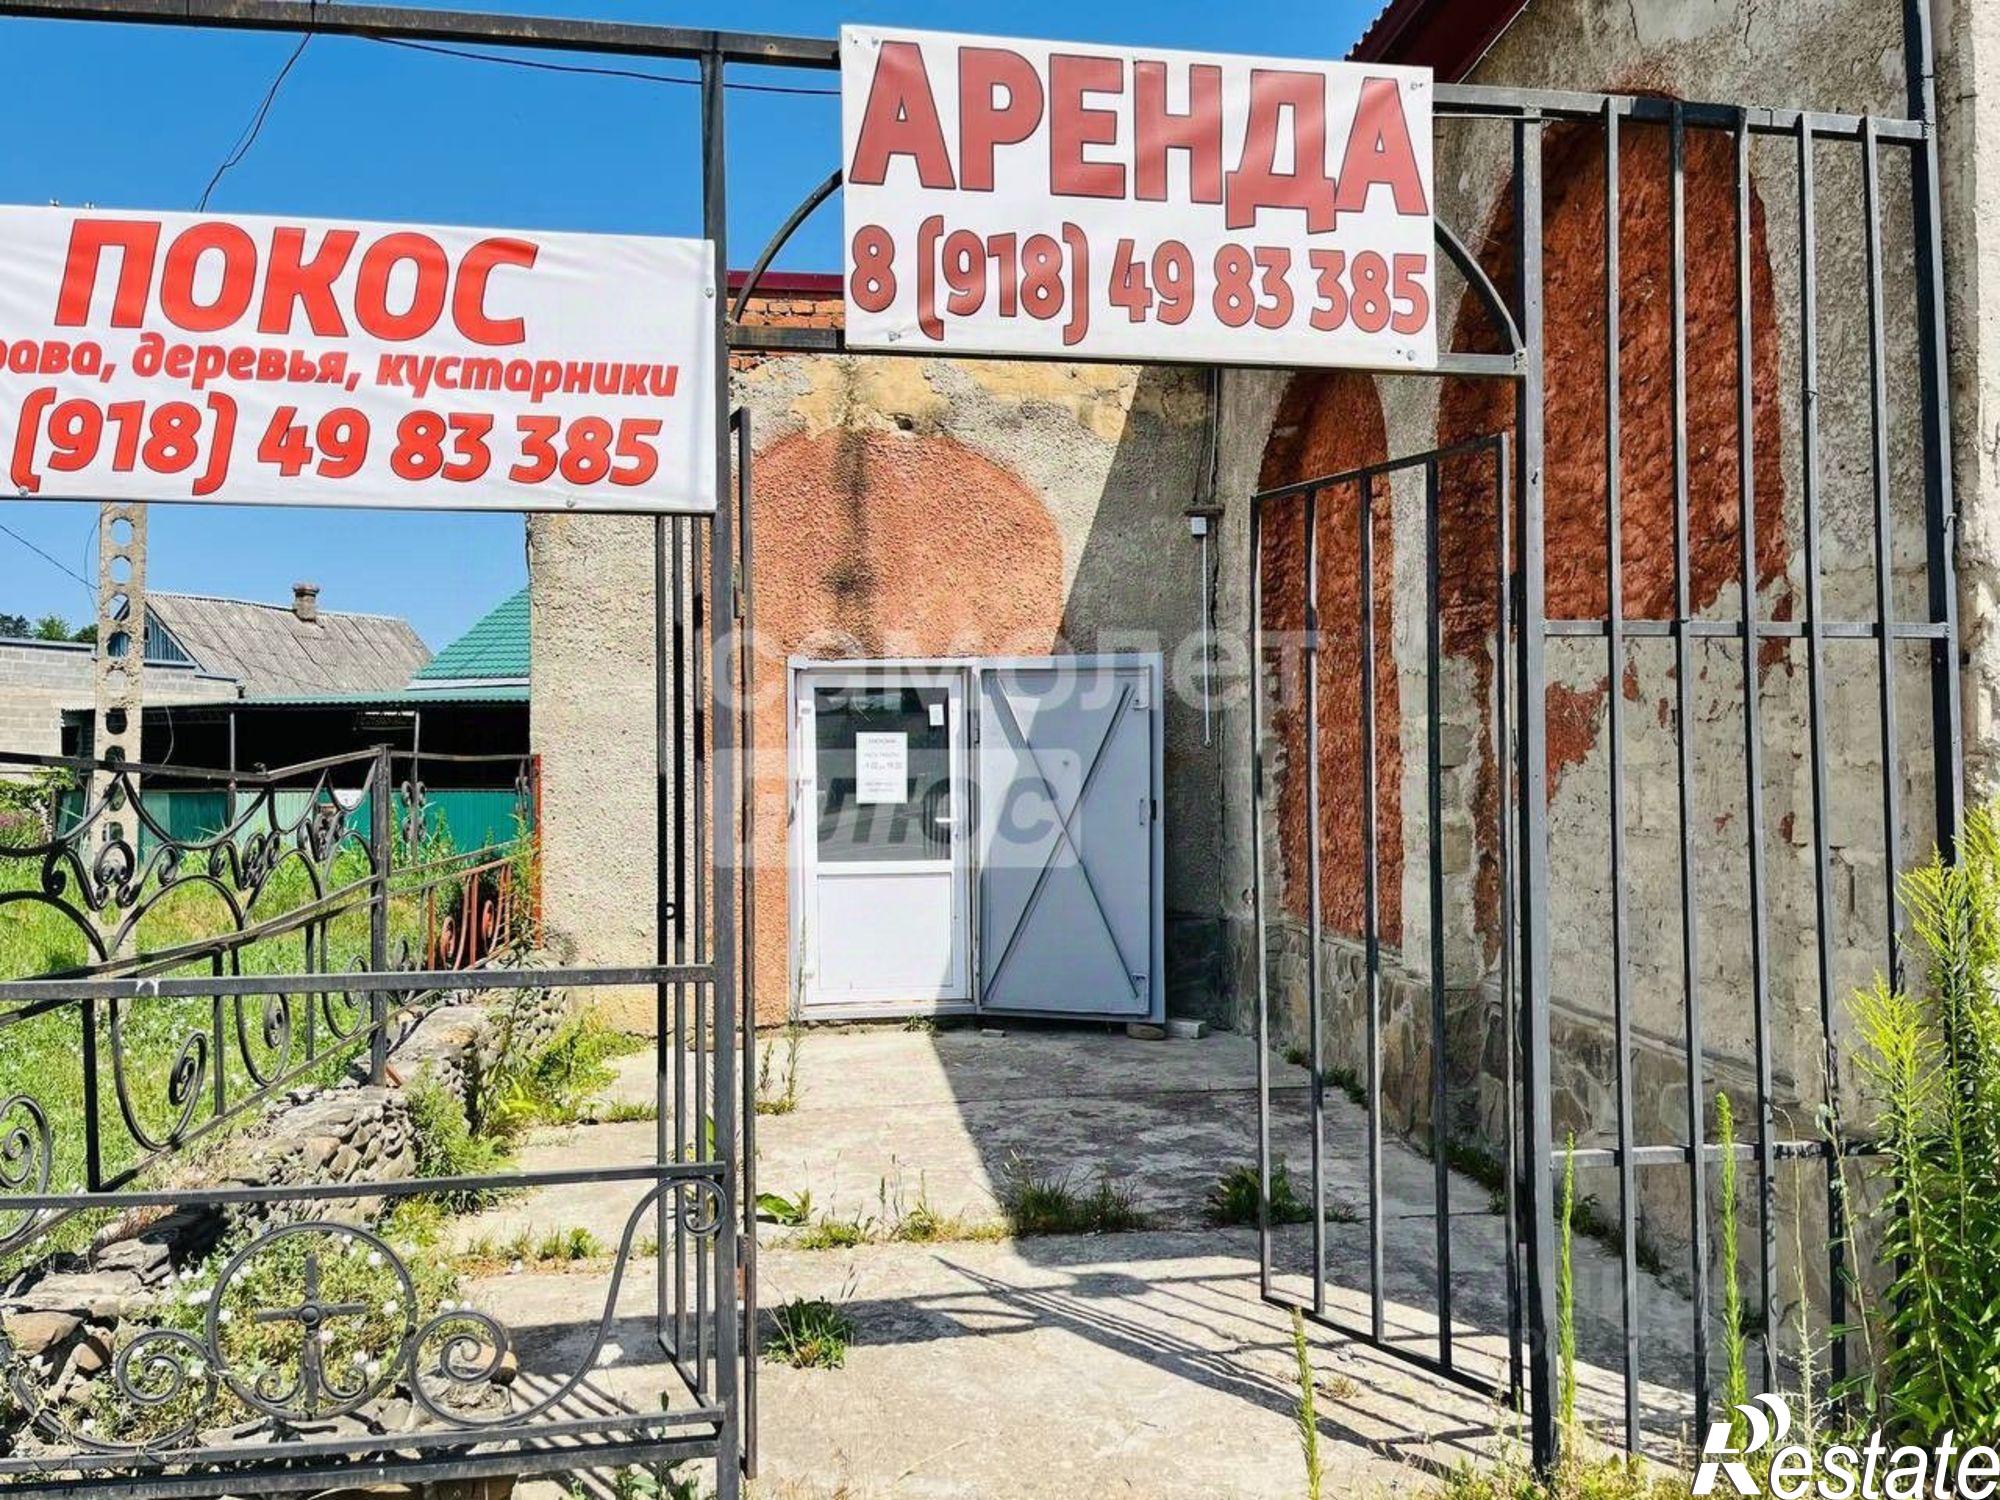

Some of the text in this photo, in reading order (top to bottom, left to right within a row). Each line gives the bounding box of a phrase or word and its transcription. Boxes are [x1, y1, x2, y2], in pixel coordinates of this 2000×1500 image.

[849, 41, 1428, 234] АРЕНДА
[54, 219, 538, 347] ПОКОС
[851, 216, 1428, 345] 8 (918) 49 83 385
[132, 331, 360, 393] деревья,
[376, 353, 678, 403] кустарники
[10, 386, 662, 495] (918) 49 83 385
